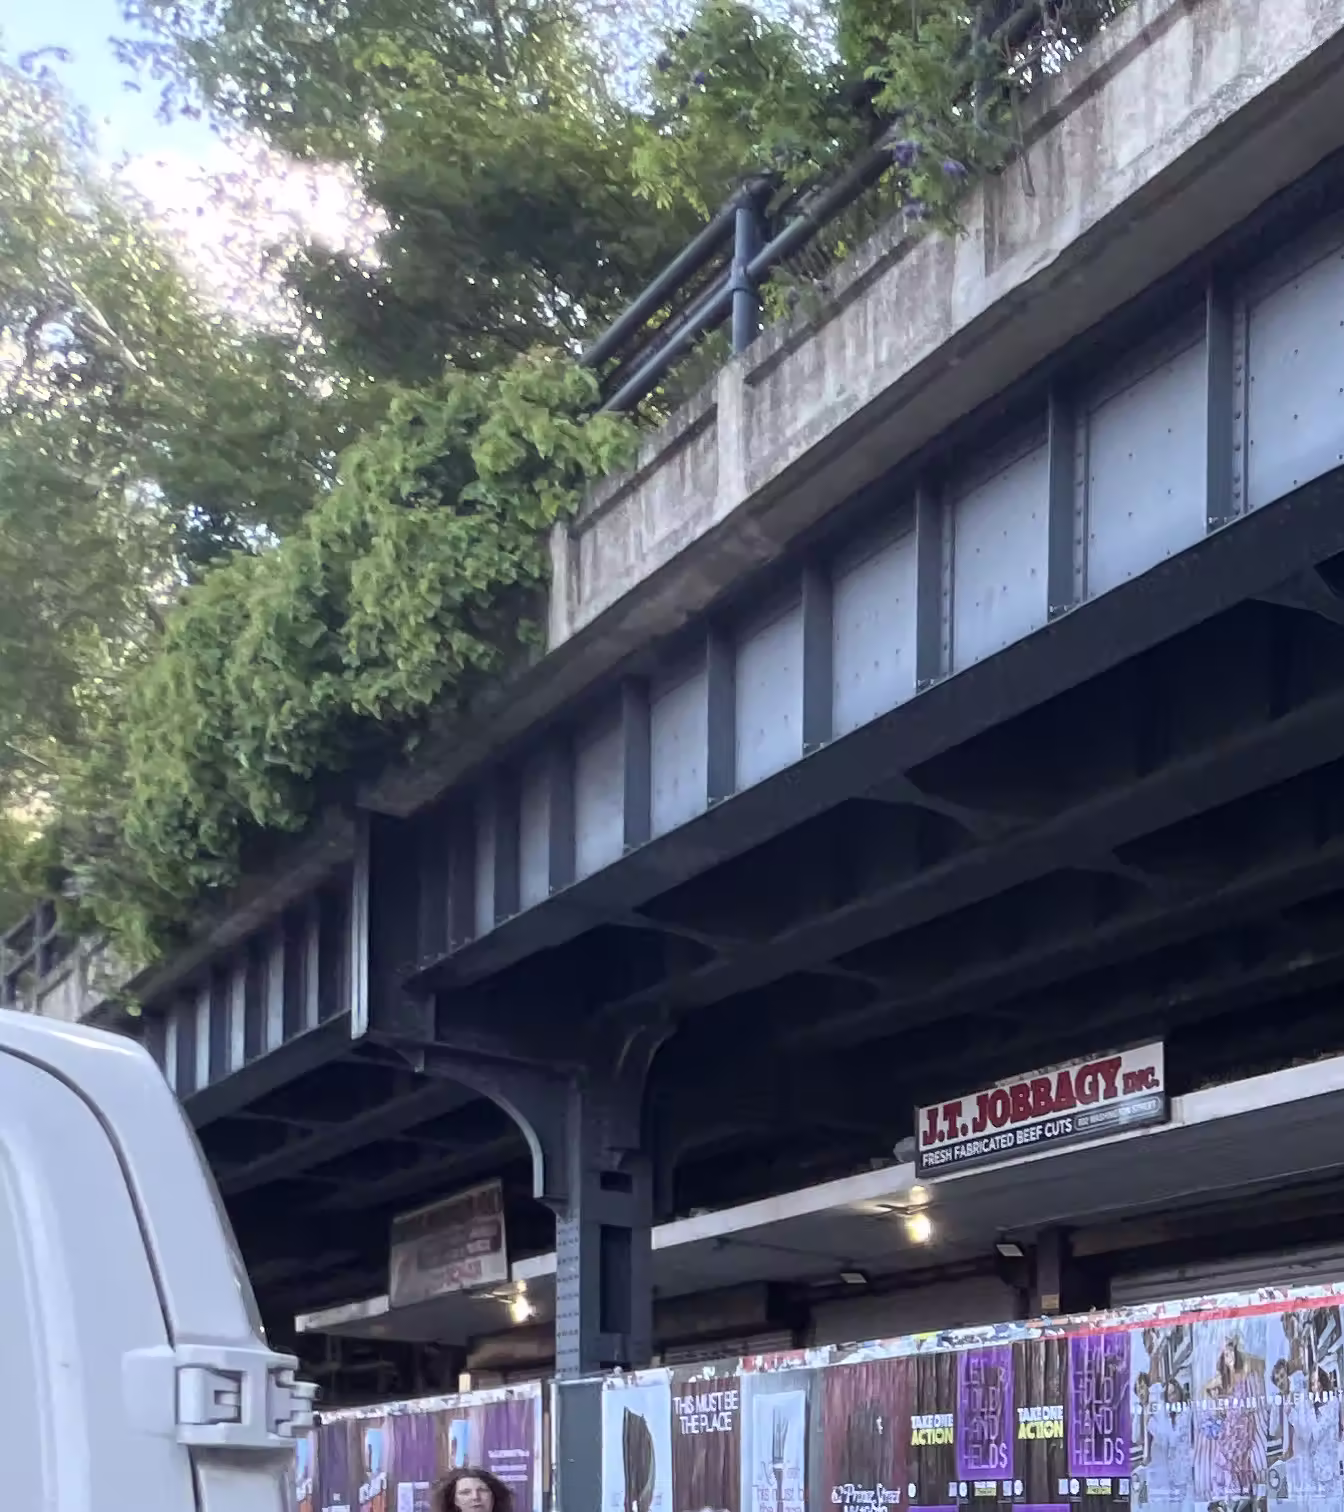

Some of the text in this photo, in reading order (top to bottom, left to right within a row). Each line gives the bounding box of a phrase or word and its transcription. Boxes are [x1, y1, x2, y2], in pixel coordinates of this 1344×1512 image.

[923, 1100, 970, 1146] J.T.
[972, 1056, 1122, 1133] JOBBAGY
[922, 1147, 953, 1168] FRESH
[953, 1133, 1015, 1160] FABRICATED
[1016, 1124, 1043, 1146] BEEF
[1044, 1117, 1073, 1138] CUTS
[672, 1389, 739, 1415] THIS MUST BE
[679, 1411, 732, 1435] THE PLACE
[910, 1413, 954, 1429] TAKE ONE
[1017, 1405, 1064, 1422] TAKE ONE
[910, 1428, 954, 1446] ACTION
[1017, 1421, 1064, 1440] ACTION
